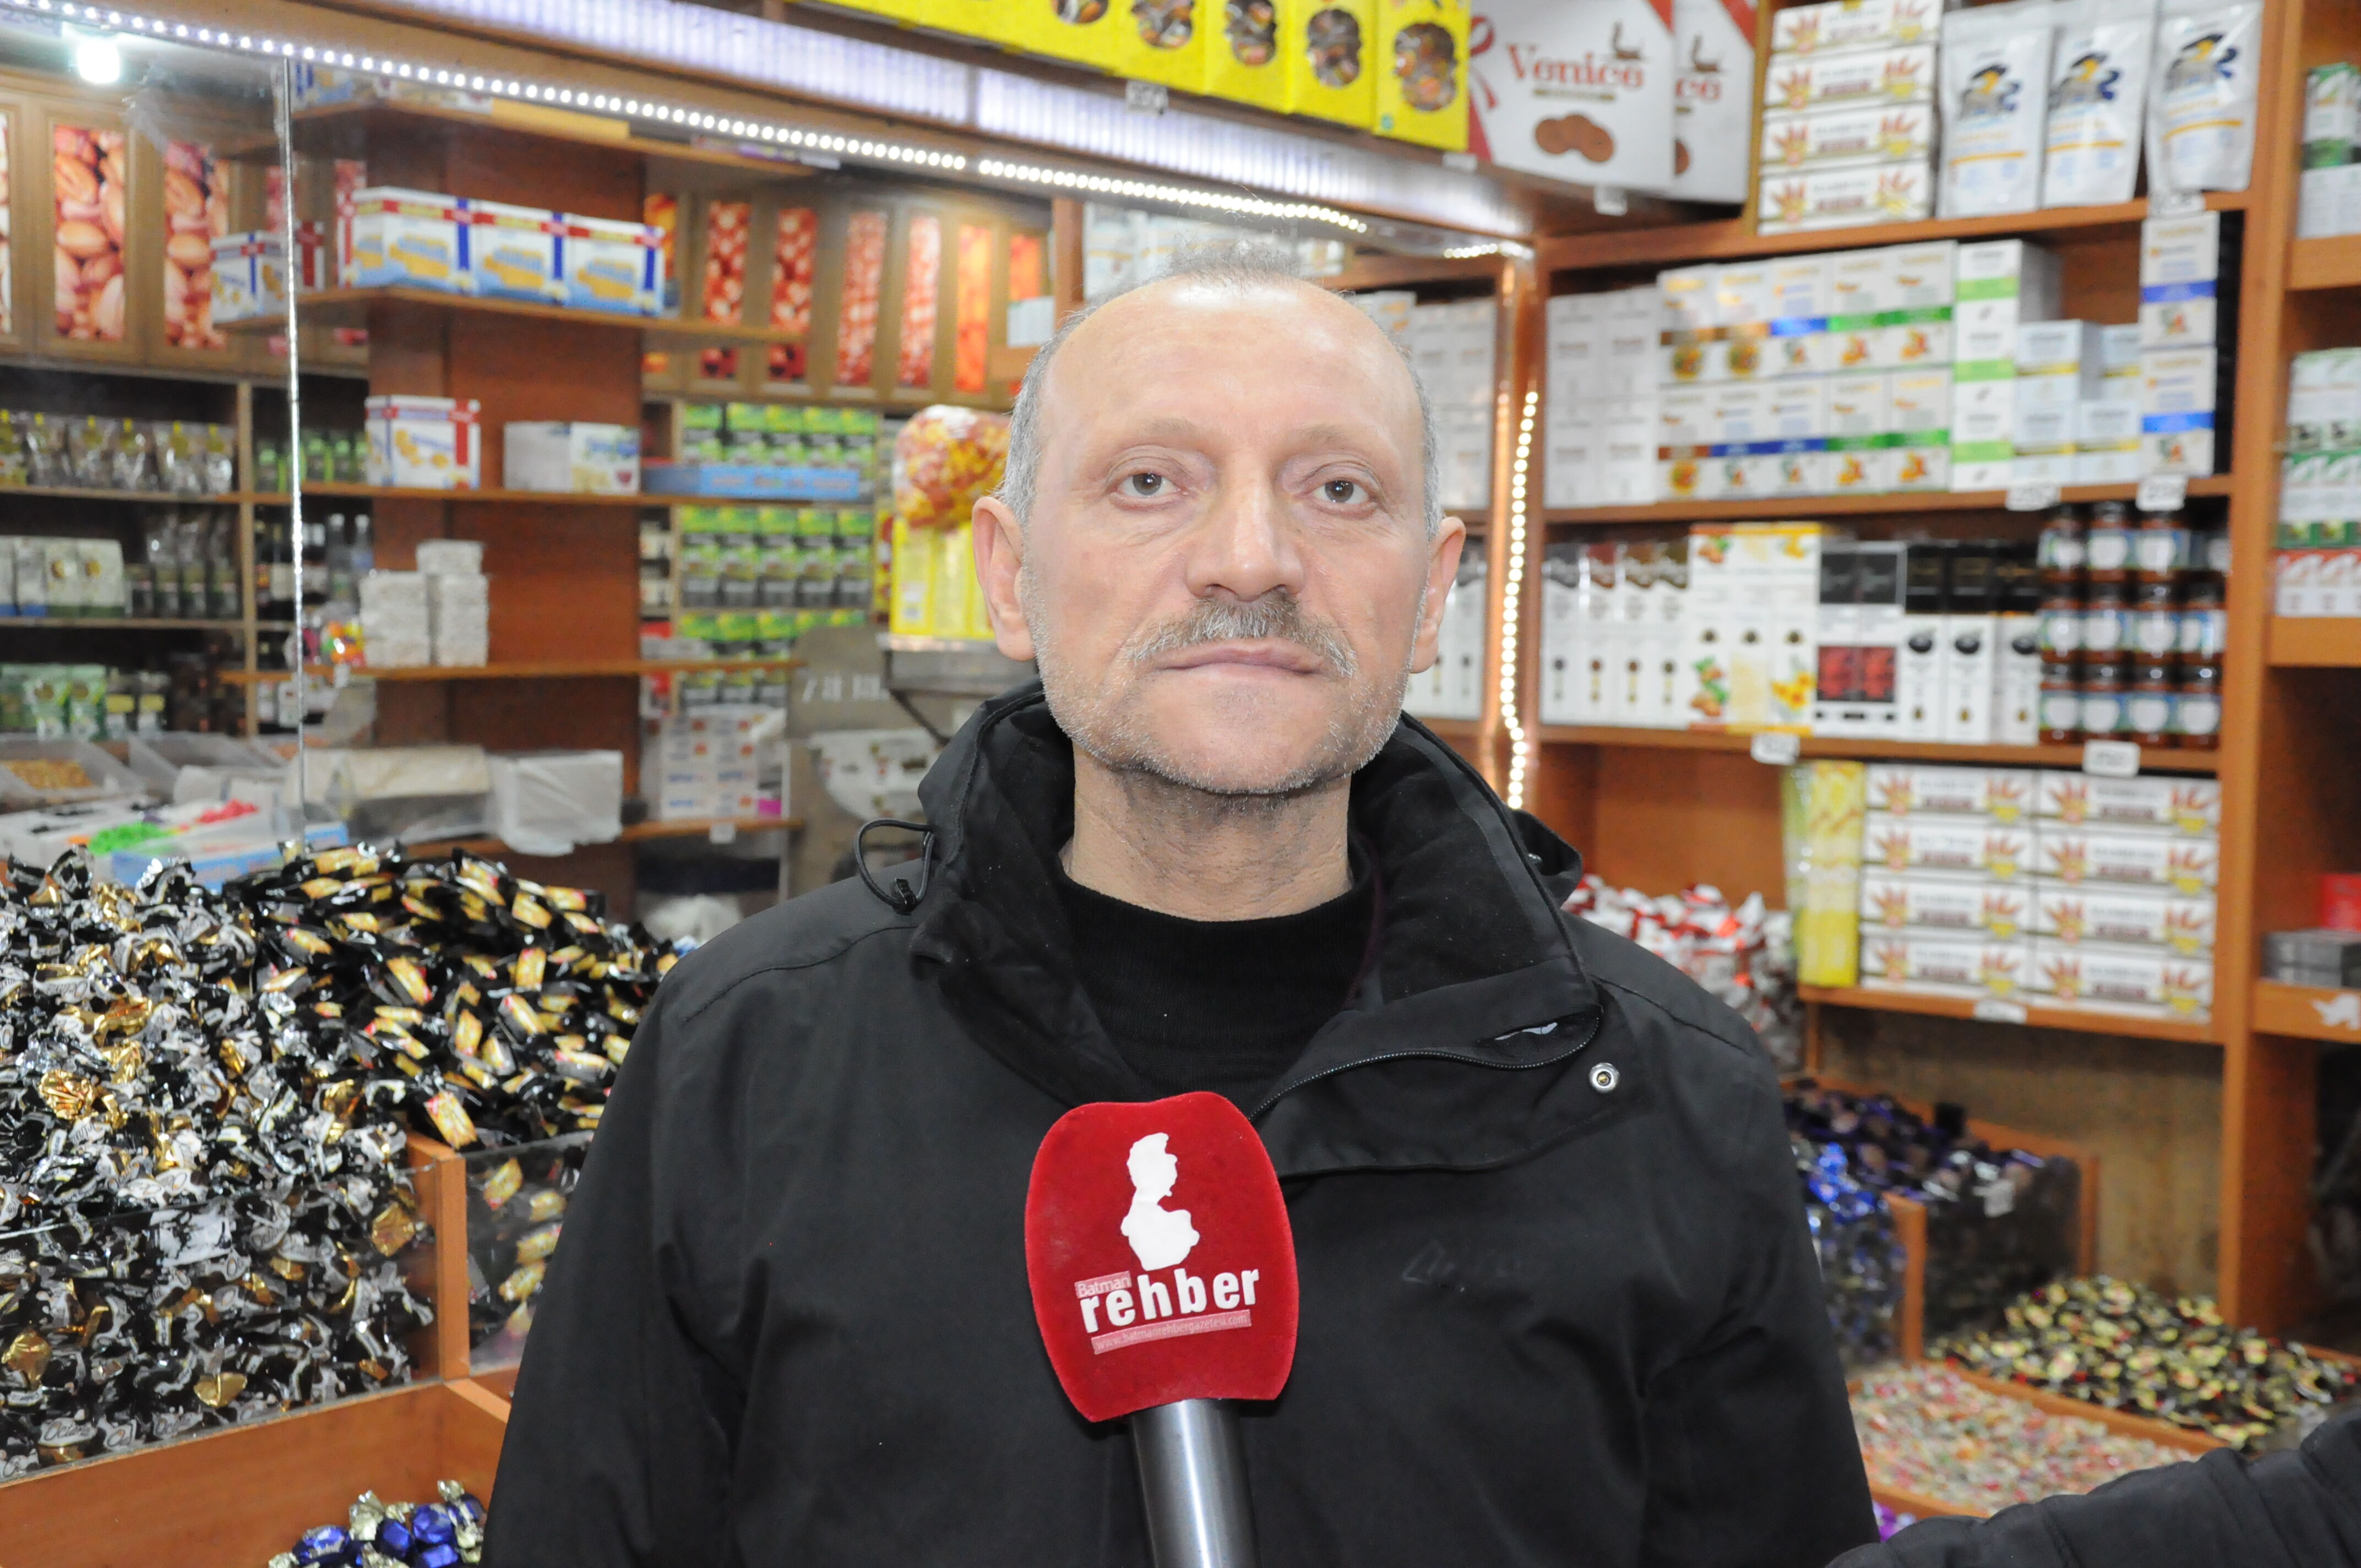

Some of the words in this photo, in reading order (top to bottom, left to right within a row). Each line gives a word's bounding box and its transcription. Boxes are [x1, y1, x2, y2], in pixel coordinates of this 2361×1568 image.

[1078, 1276, 1131, 1297] Batman
[1080, 1268, 1260, 1333] rehber
[1095, 1314, 1248, 1349] www.batmanrehbergazetesi.com
